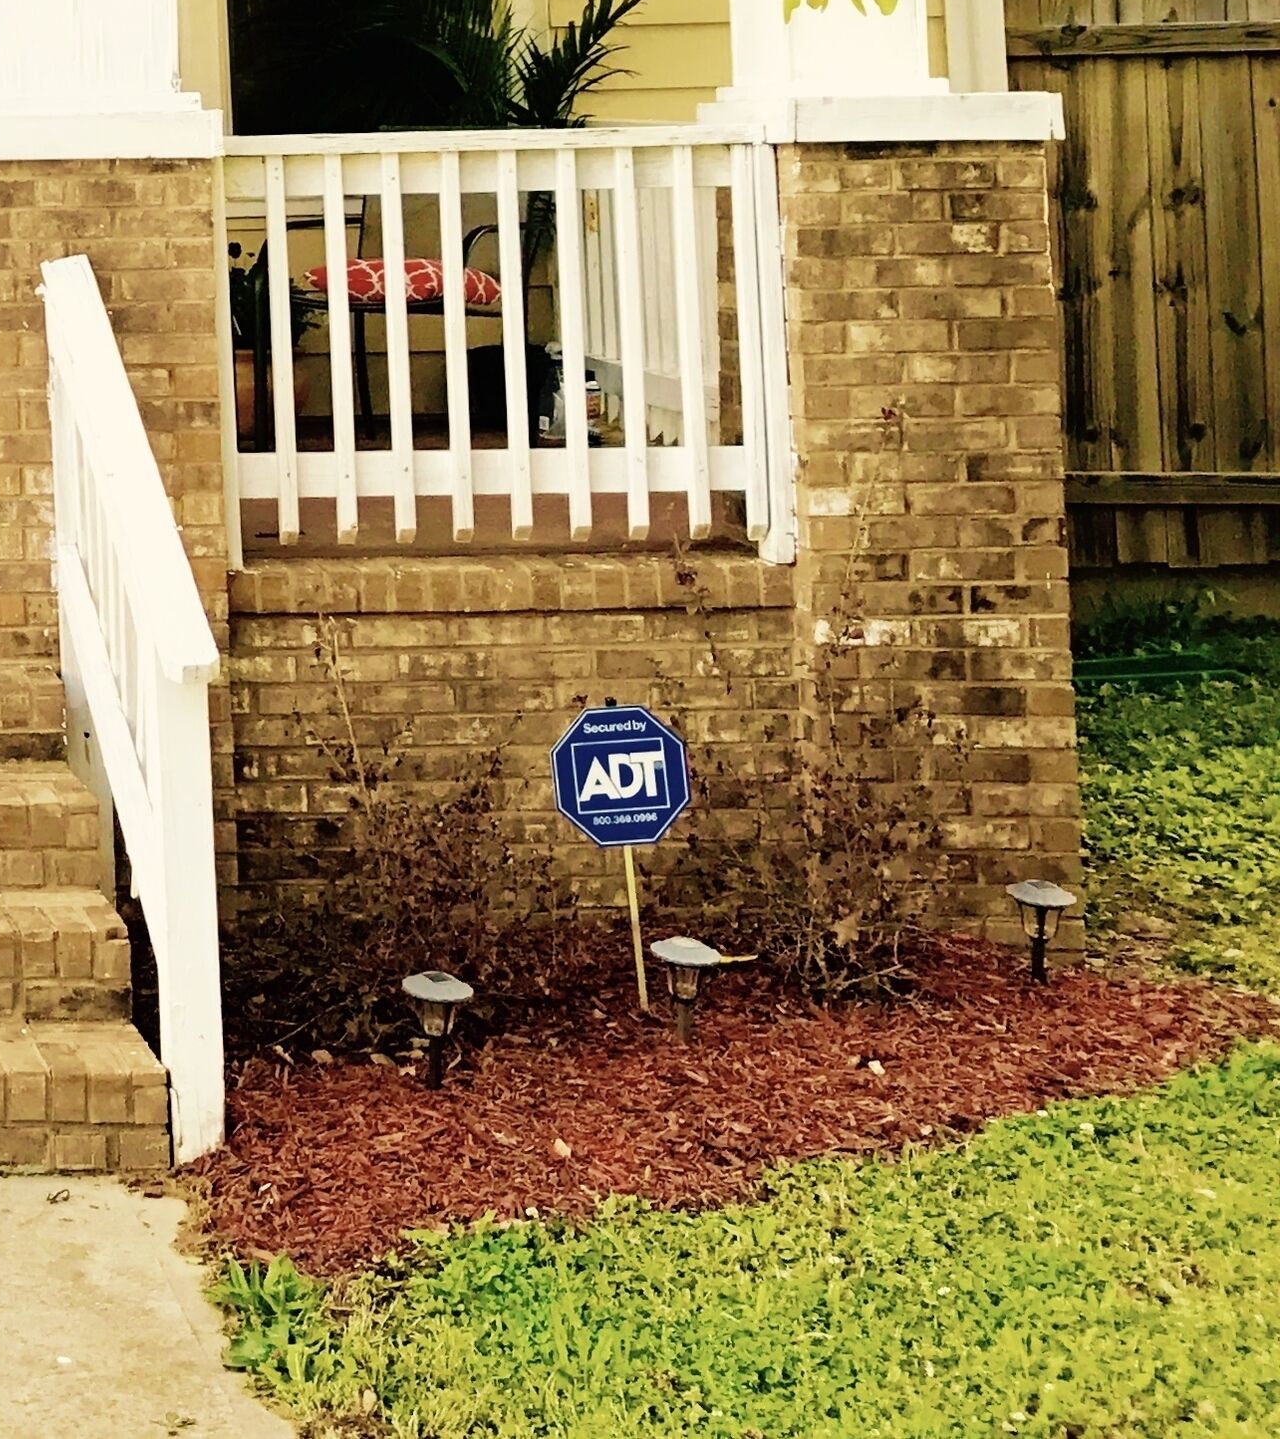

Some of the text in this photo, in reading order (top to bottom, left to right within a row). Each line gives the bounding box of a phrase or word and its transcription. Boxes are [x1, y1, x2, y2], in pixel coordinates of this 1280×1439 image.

[583, 720, 647, 734] Secured by
[579, 750, 663, 802] ADT
